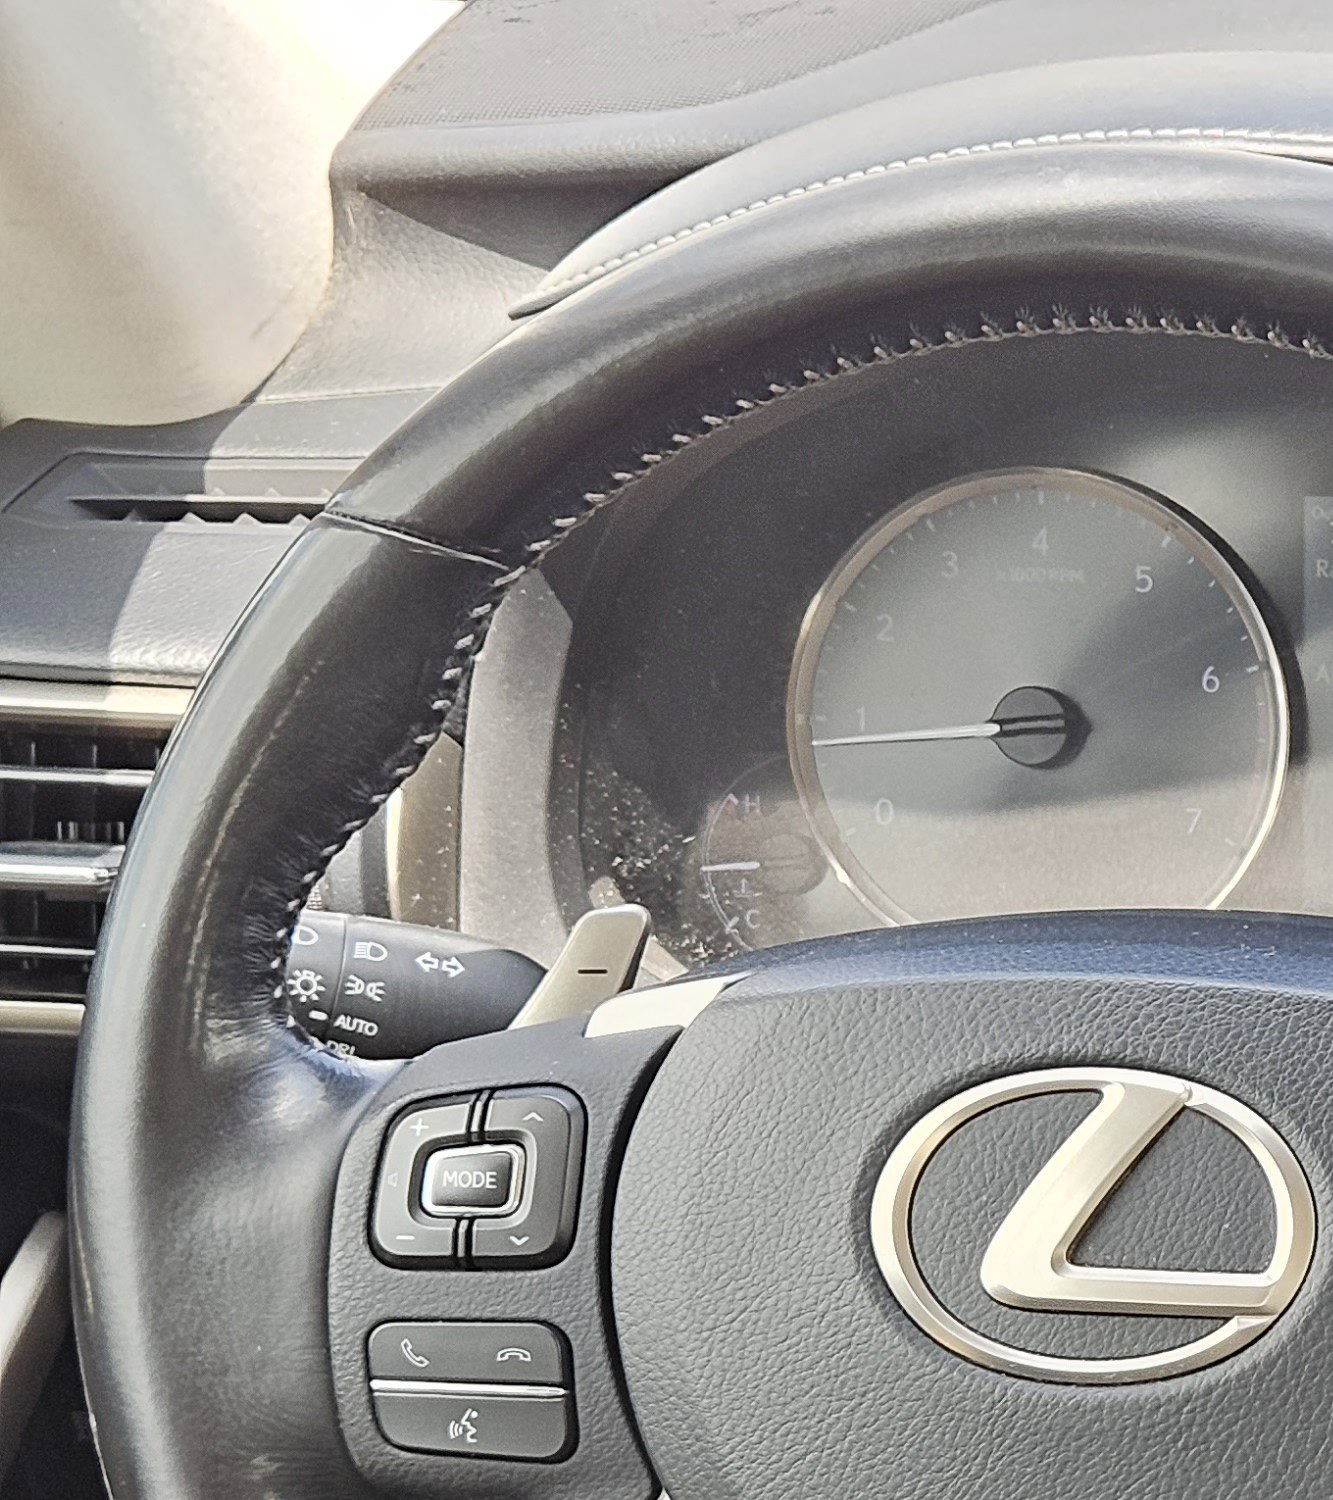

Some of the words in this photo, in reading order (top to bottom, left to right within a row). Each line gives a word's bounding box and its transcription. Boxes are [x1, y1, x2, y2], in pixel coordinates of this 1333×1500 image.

[1032, 526, 1049, 556] 4
[941, 551, 958, 577] 3
[1135, 565, 1154, 593] 5
[876, 614, 895, 643] 2
[1201, 666, 1220, 694] 6
[876, 798, 894, 826] 0
[1186, 808, 1202, 835] 7
[333, 1014, 379, 1036] AUTO
[442, 1169, 498, 1189] MODE
